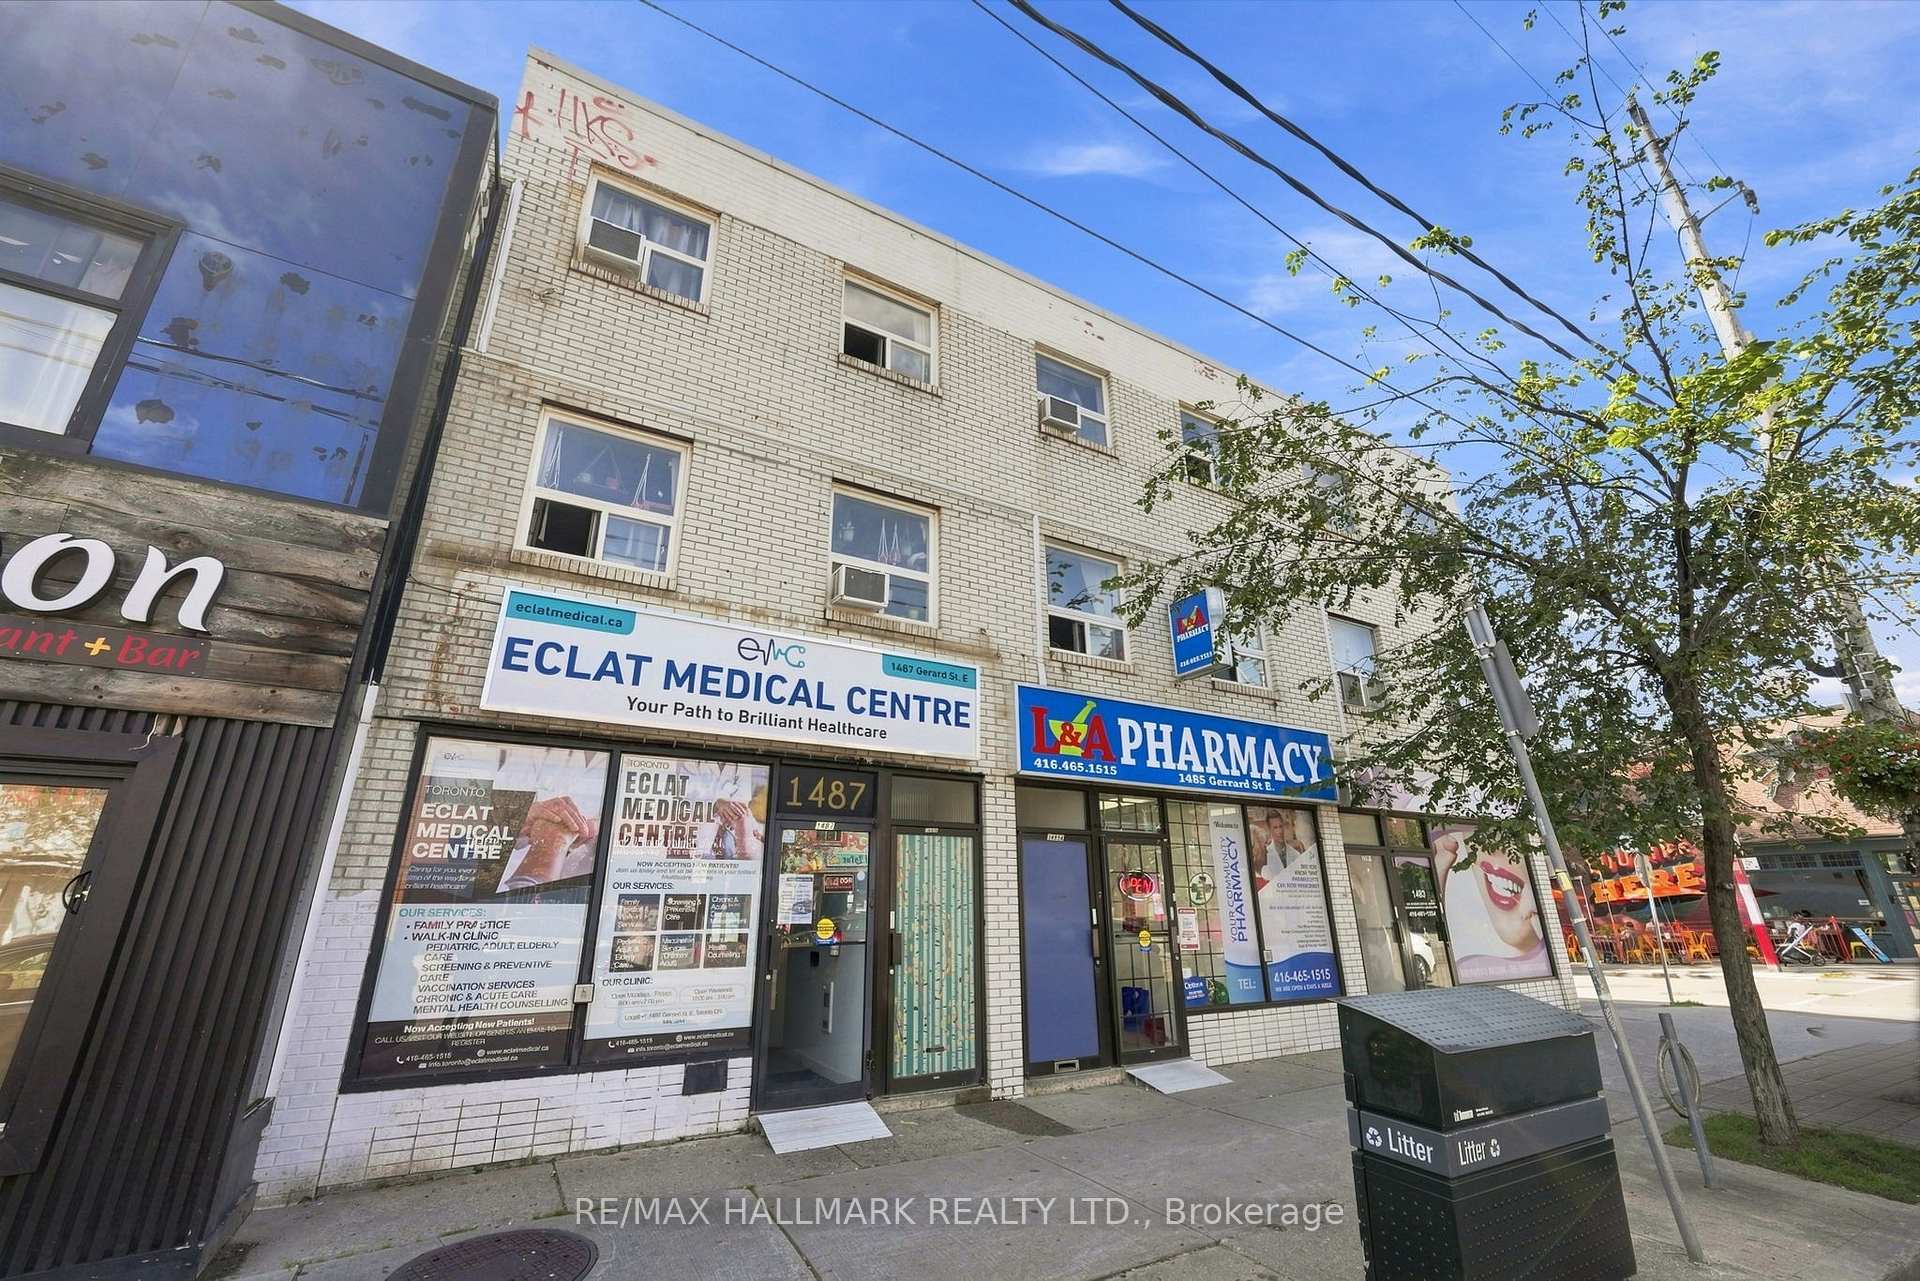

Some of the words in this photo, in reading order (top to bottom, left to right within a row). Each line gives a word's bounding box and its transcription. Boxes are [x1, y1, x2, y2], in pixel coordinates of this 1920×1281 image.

[515, 602, 623, 628] eclatmedical.ca
[1177, 624, 1210, 642] PHARMACY
[116, 634, 200, 670] Bar
[891, 661, 914, 675] 1487
[916, 666, 947, 680] Gerard
[962, 674, 969, 683] E
[501, 636, 653, 687] ECLAT
[663, 659, 835, 711] MEDICAL
[847, 686, 971, 729] CENTRE
[627, 695, 668, 715] Your
[673, 702, 712, 720] Path
[717, 706, 733, 722] to
[739, 709, 803, 730] Brilliant
[808, 718, 887, 740] Healthcare
[1117, 717, 1322, 784] PHARMACY
[629, 759, 670, 770] TORONTO
[1033, 757, 1118, 776] 416.465.1515
[425, 784, 486, 798] TORONTO
[625, 771, 690, 796] ECLAT
[1179, 773, 1206, 786] 1485
[1208, 776, 1250, 790] Gerrard
[1251, 779, 1263, 791] St
[786, 776, 866, 811] 1487
[420, 802, 494, 821] ECLAT
[621, 797, 716, 823] MEDICAL
[416, 822, 514, 841] MEDICAL
[618, 823, 698, 847] CENTRE
[412, 842, 502, 860] CENTRE
[1220, 836, 1235, 907] COMMUNITY
[612, 882, 631, 890] OUR
[1226, 836, 1248, 942] PHARMACY
[400, 908, 425, 918] OUR
[427, 908, 487, 917] SERVICES:
[414, 921, 454, 930] FAMILY
[412, 932, 461, 941] WALK-IN
[463, 931, 498, 941] CLINIC
[426, 943, 480, 951] PEDIATRIC,
[517, 941, 559, 950] ELDERLY
[422, 963, 482, 972] SCREENING
[484, 962, 490, 970] &
[493, 961, 552, 970] PREVENTIVE
[424, 953, 453, 962] CARE
[420, 973, 449, 982] CARE
[602, 978, 621, 987] OUR
[1237, 978, 1257, 990] TEL:
[1274, 968, 1331, 983] 416-465-1515
[418, 983, 485, 992] VACCINATION
[487, 981, 535, 990] SERVICES
[416, 993, 463, 1003] CHRONIC
[466, 993, 472, 1001] &
[475, 991, 508, 1001] ACUTE
[511, 990, 537, 999] CARE
[413, 1004, 457, 1014] MENTAL
[458, 1002, 498, 1012] HEALTH
[500, 998, 568, 1009] COUNSELLING
[404, 1024, 426, 1033] Now
[427, 1021, 474, 1033] Accepting
[475, 1020, 496, 1029] New
[497, 1018, 535, 1028] Patients!
[1387, 1127, 1433, 1164] Litter
[1458, 1140, 1486, 1166] Litter
